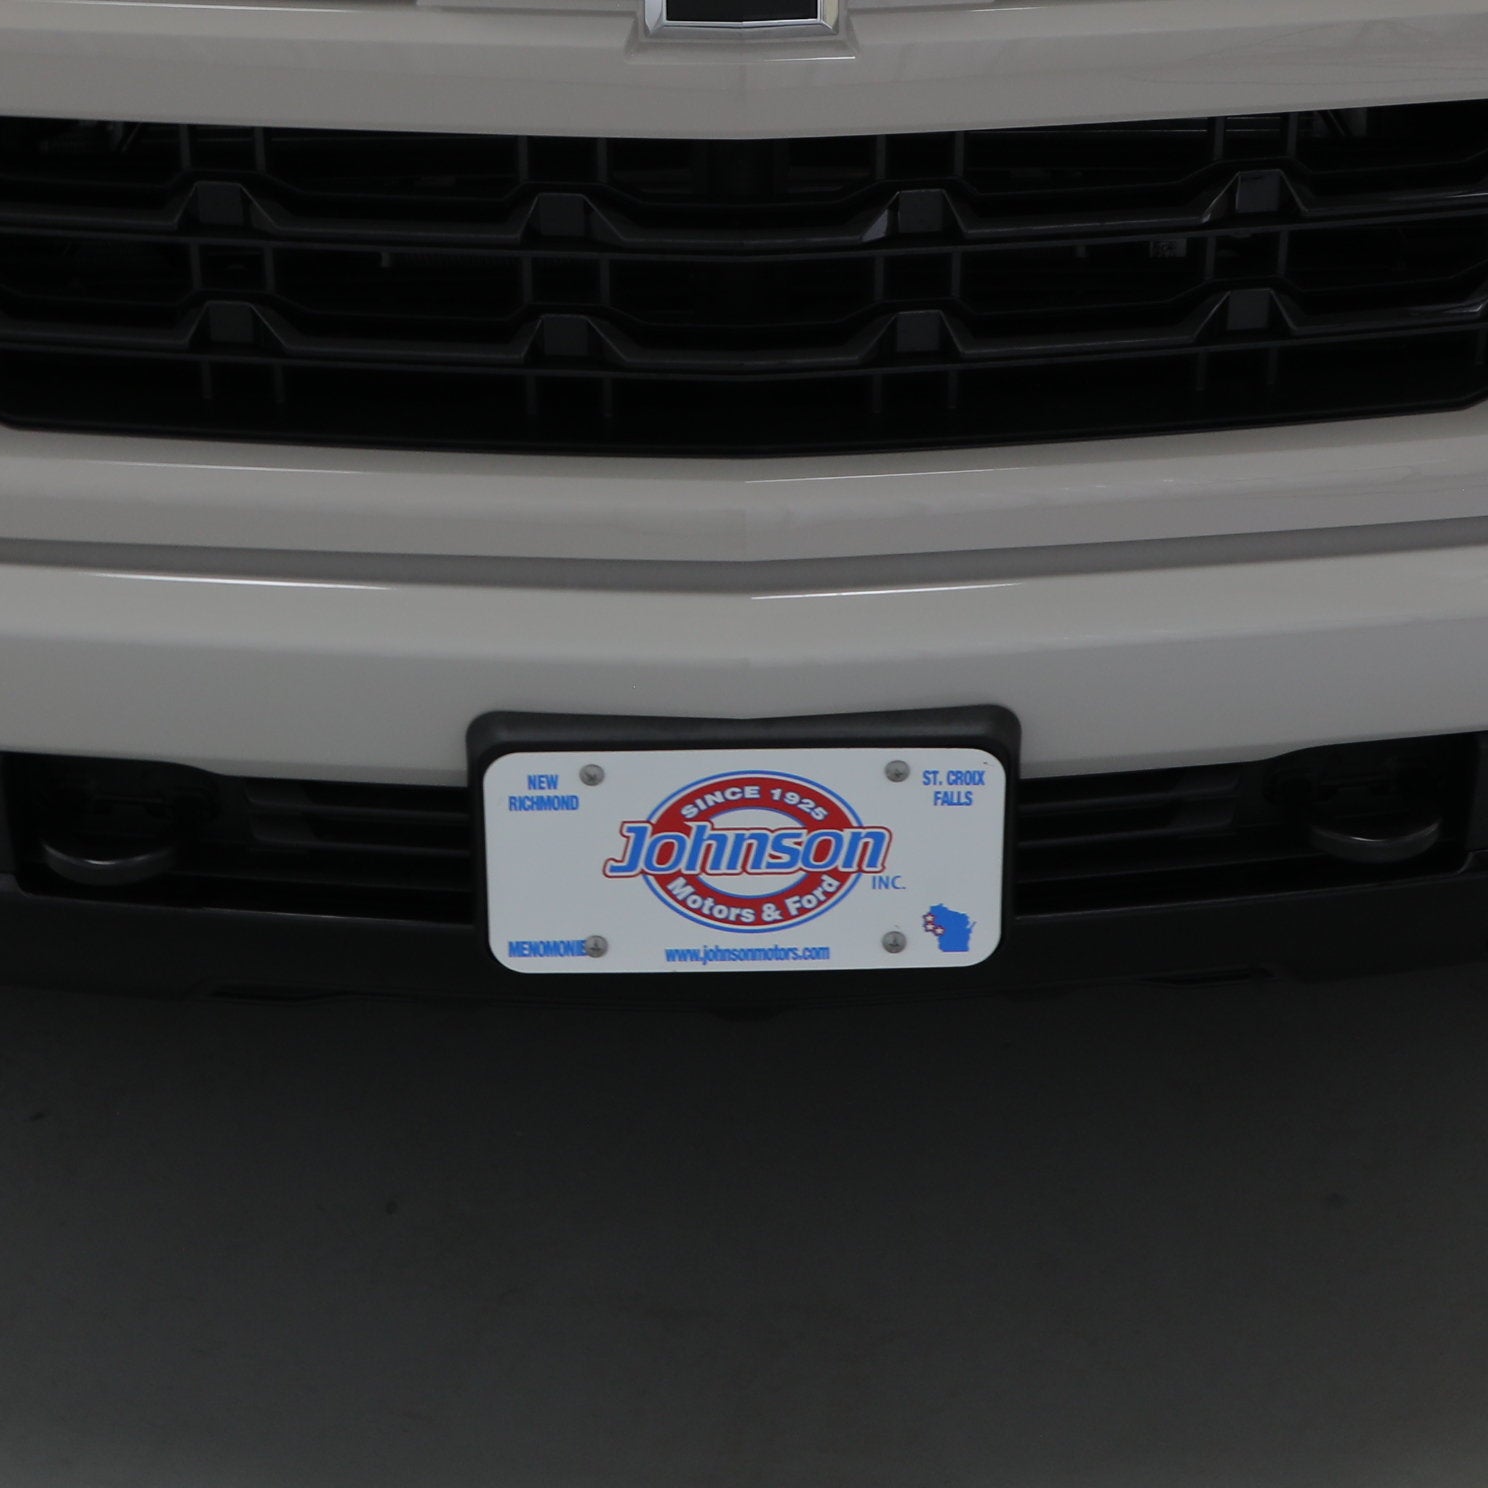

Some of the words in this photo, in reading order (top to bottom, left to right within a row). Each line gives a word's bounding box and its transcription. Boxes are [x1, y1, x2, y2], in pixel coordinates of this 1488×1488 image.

[527, 774, 559, 791] NEW
[922, 769, 943, 786] ST.
[946, 769, 986, 786] CROIX
[508, 794, 580, 812] RICHMOND
[680, 785, 761, 820] SINCE
[770, 787, 829, 822] 1925
[933, 790, 973, 807] FALLS
[605, 822, 890, 876] Johnson
[871, 874, 907, 890] INC.
[665, 876, 756, 923] Motors
[761, 902, 784, 922] &
[784, 874, 841, 916] Ford
[664, 944, 831, 965] www.johnsonmotors.com
